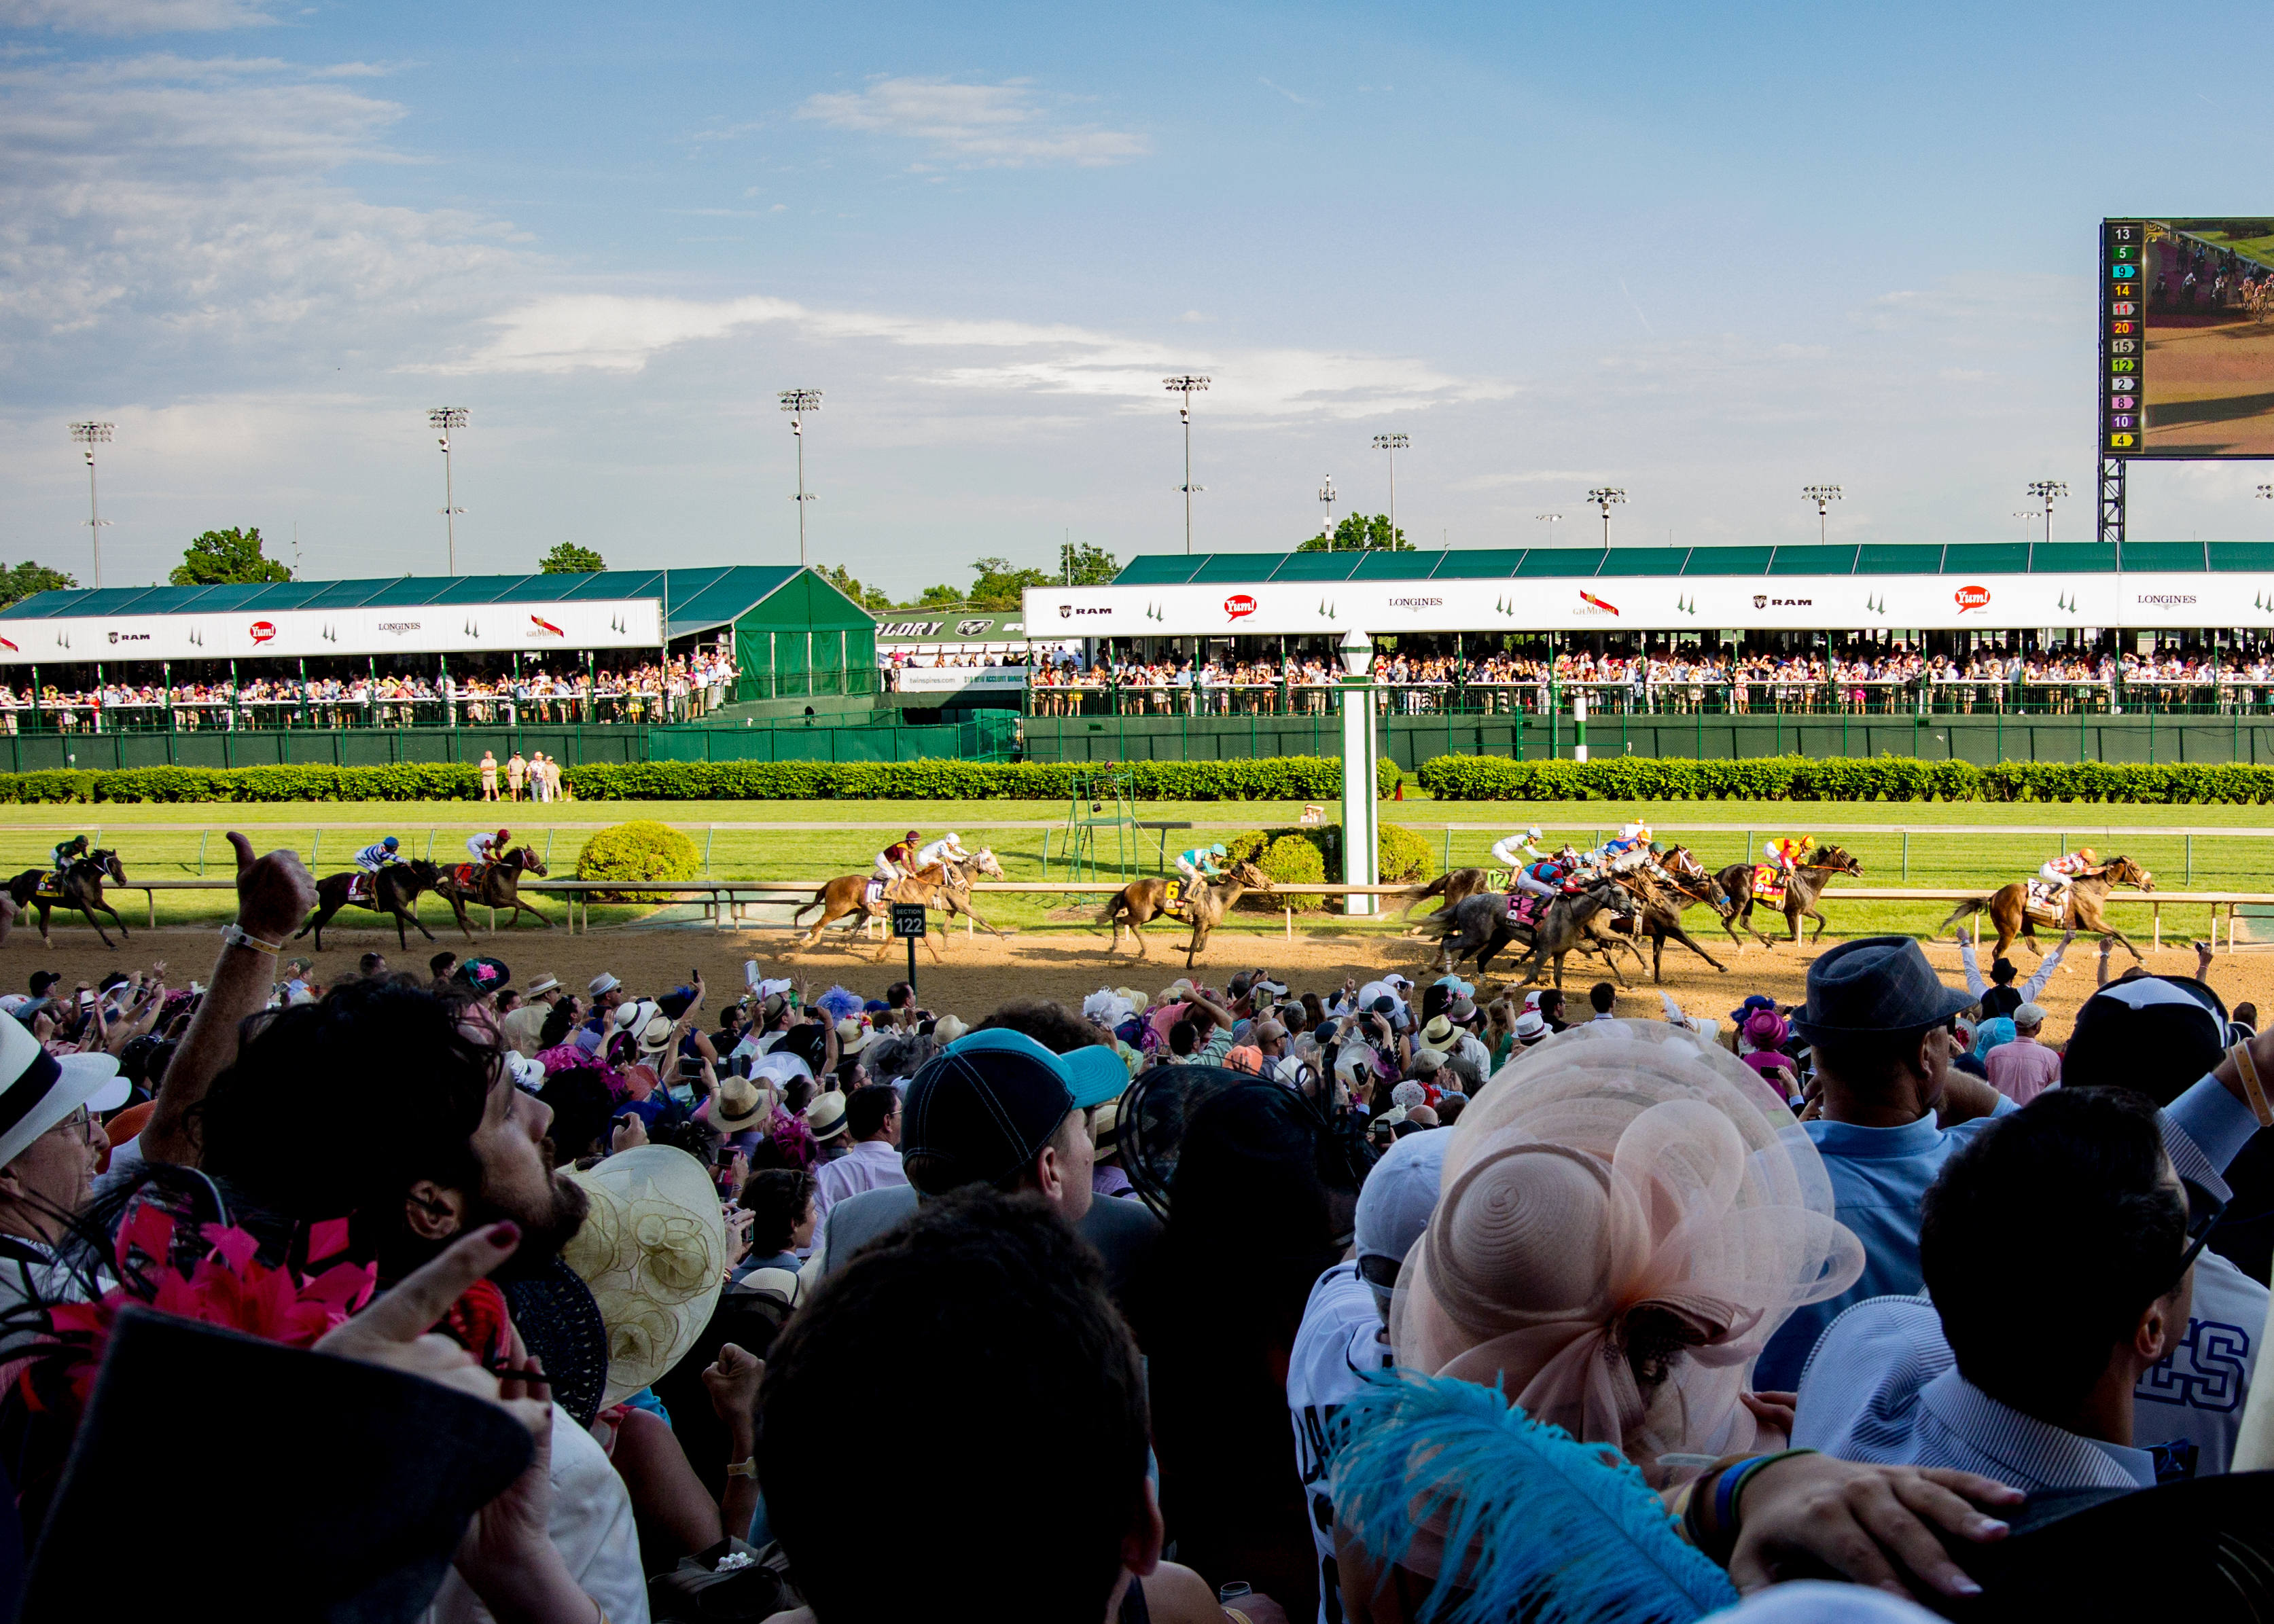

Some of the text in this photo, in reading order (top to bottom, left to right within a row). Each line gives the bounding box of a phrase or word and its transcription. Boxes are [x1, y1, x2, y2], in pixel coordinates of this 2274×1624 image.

[2116, 229, 2130, 240] 13
[2119, 248, 2126, 258] 5
[2118, 267, 2125, 277] 9
[2115, 285, 2129, 296] 14
[2115, 304, 2128, 314] 11
[2114, 323, 2129, 333] 20
[2115, 342, 2129, 352] 15
[2115, 361, 2129, 371] 12
[2118, 380, 2125, 389] 2
[2118, 398, 2125, 408] 8
[2114, 416, 2129, 427] 10
[2118, 435, 2125, 446] 4
[1957, 590, 1989, 603] Yum!
[2137, 595, 2197, 604] LONGINES
[1226, 599, 1256, 612] Yum!
[1389, 598, 1443, 606] LONGINES
[251, 626, 274, 636] Yum!
[378, 622, 421, 630] LONGINES
[1166, 881, 1180, 899] 6
[896, 918, 923, 933] 122
